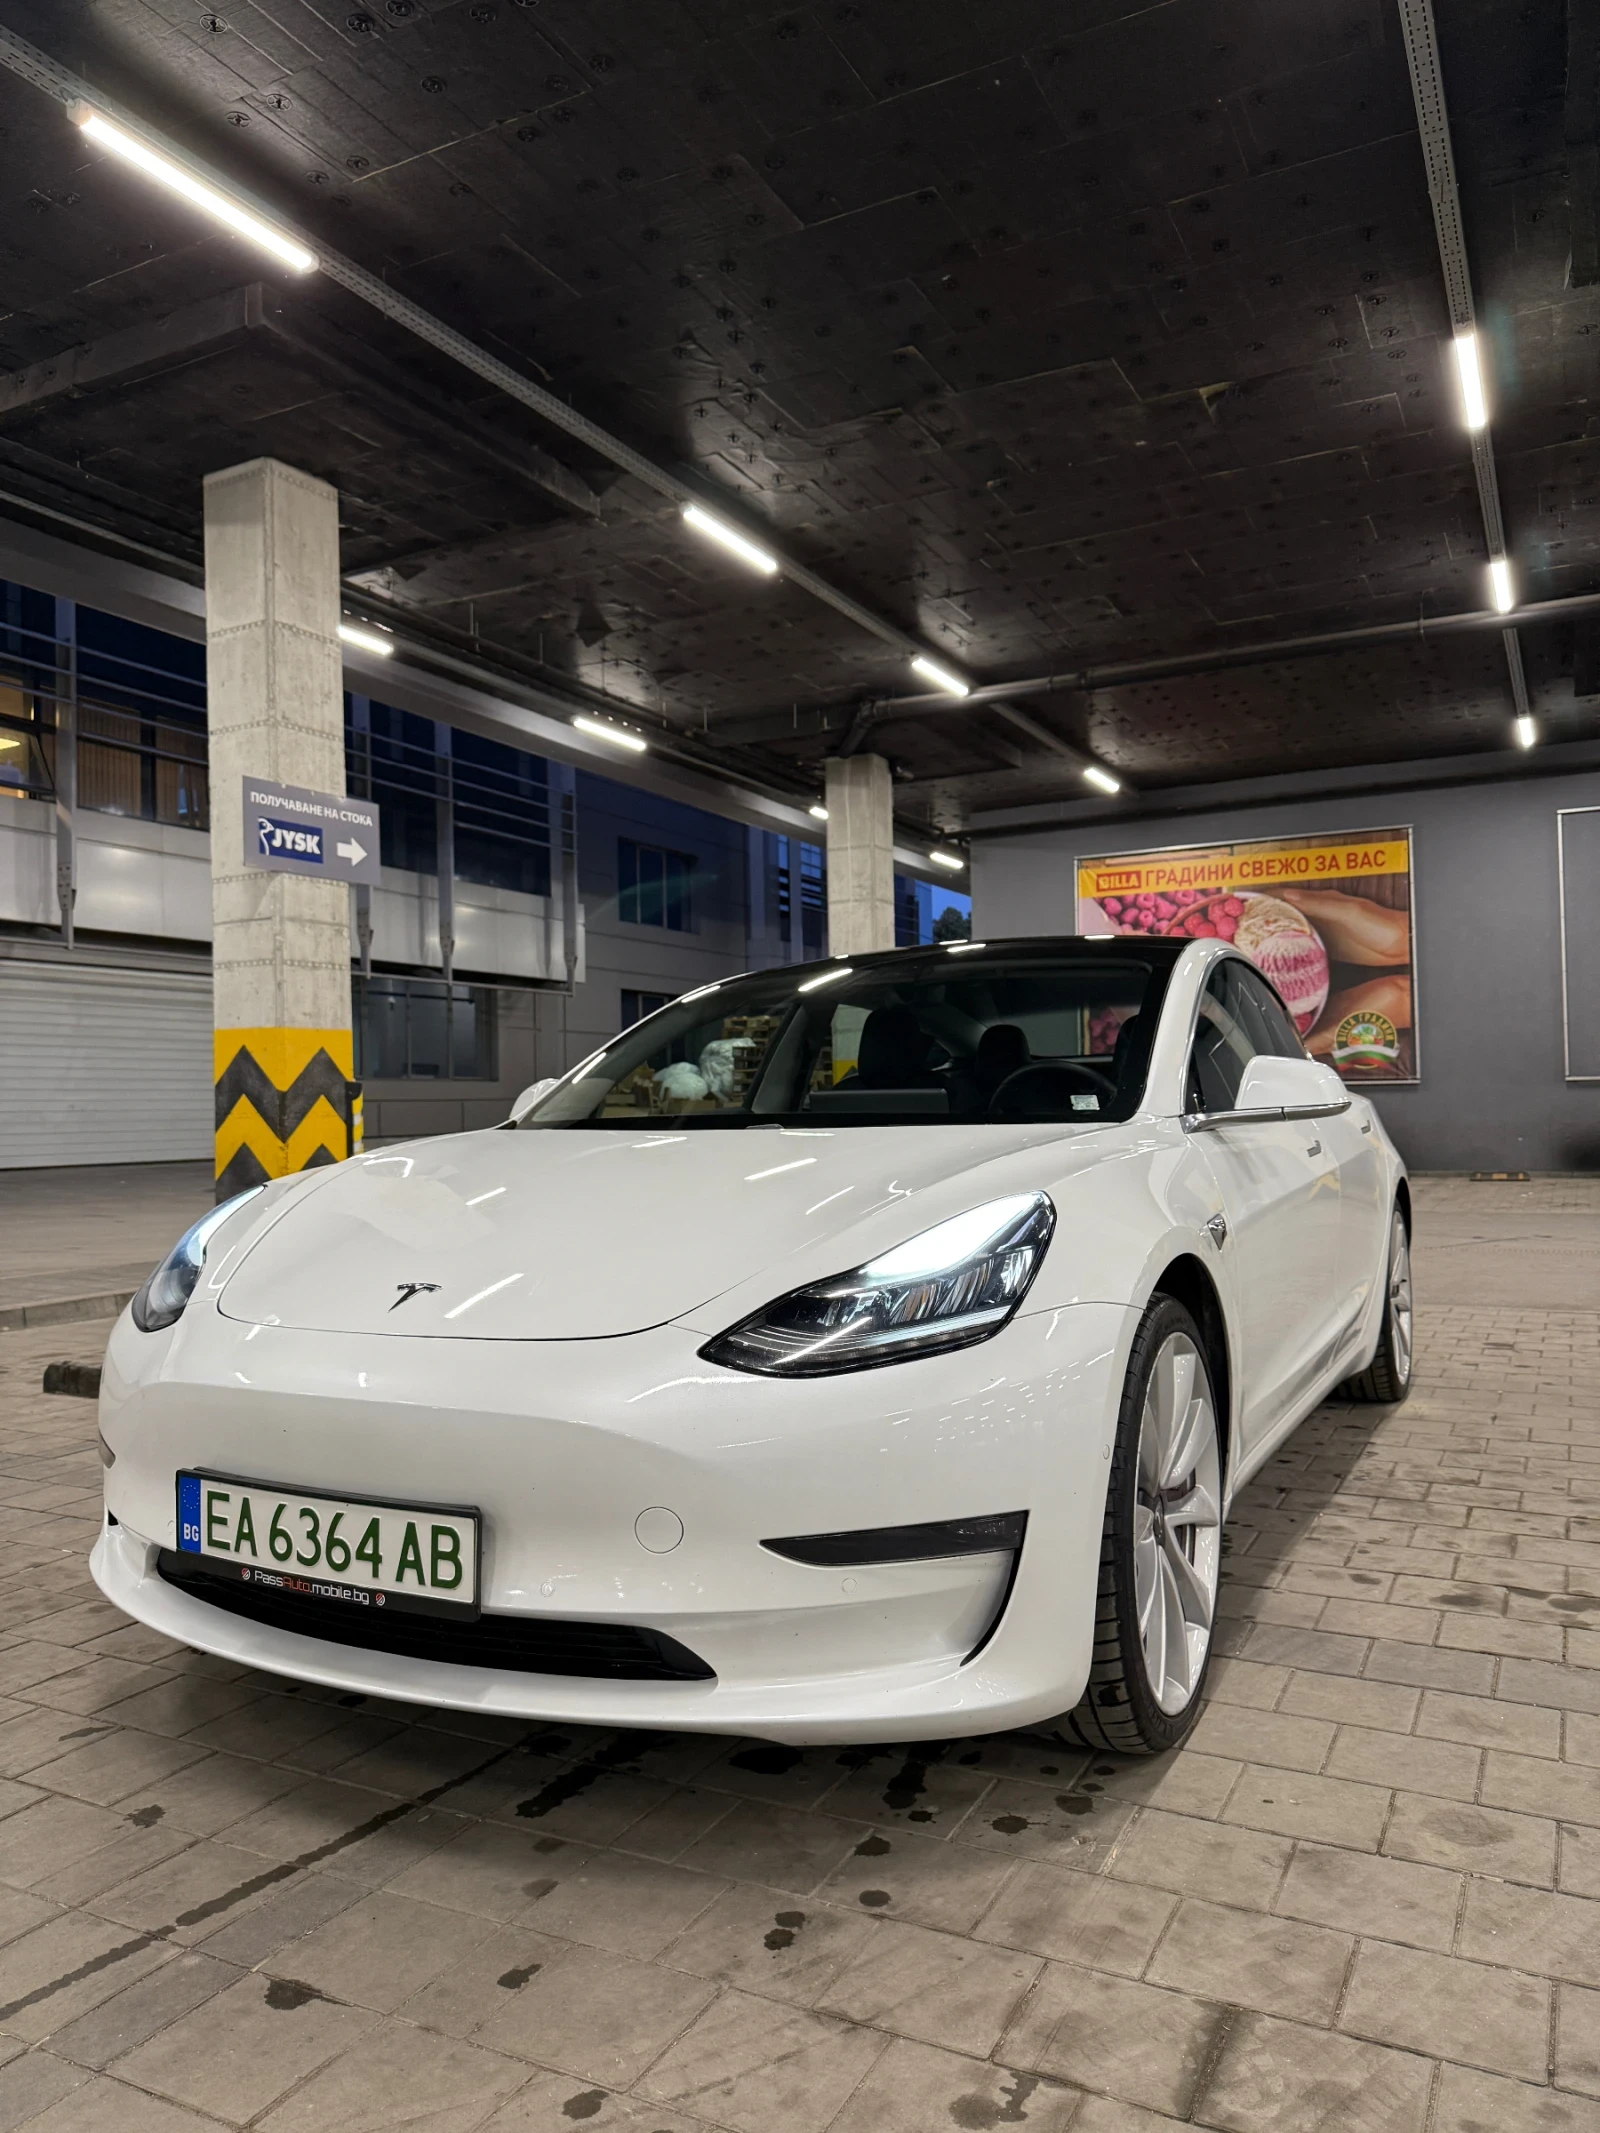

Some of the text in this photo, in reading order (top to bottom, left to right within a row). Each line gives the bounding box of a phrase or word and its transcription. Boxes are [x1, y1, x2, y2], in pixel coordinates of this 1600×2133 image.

[250, 791, 373, 827] ПОЛУЧАВАНЕ НА СТОКА
[272, 829, 321, 854] JYSK
[1098, 850, 1386, 890] BILLA ГРАДИНИ СВЕЖО ЗА ВАС
[183, 1523, 200, 1542] BG
[206, 1489, 464, 1590] EA 6364 AB
[254, 1570, 370, 1605] PassAuto.mobile.bg
